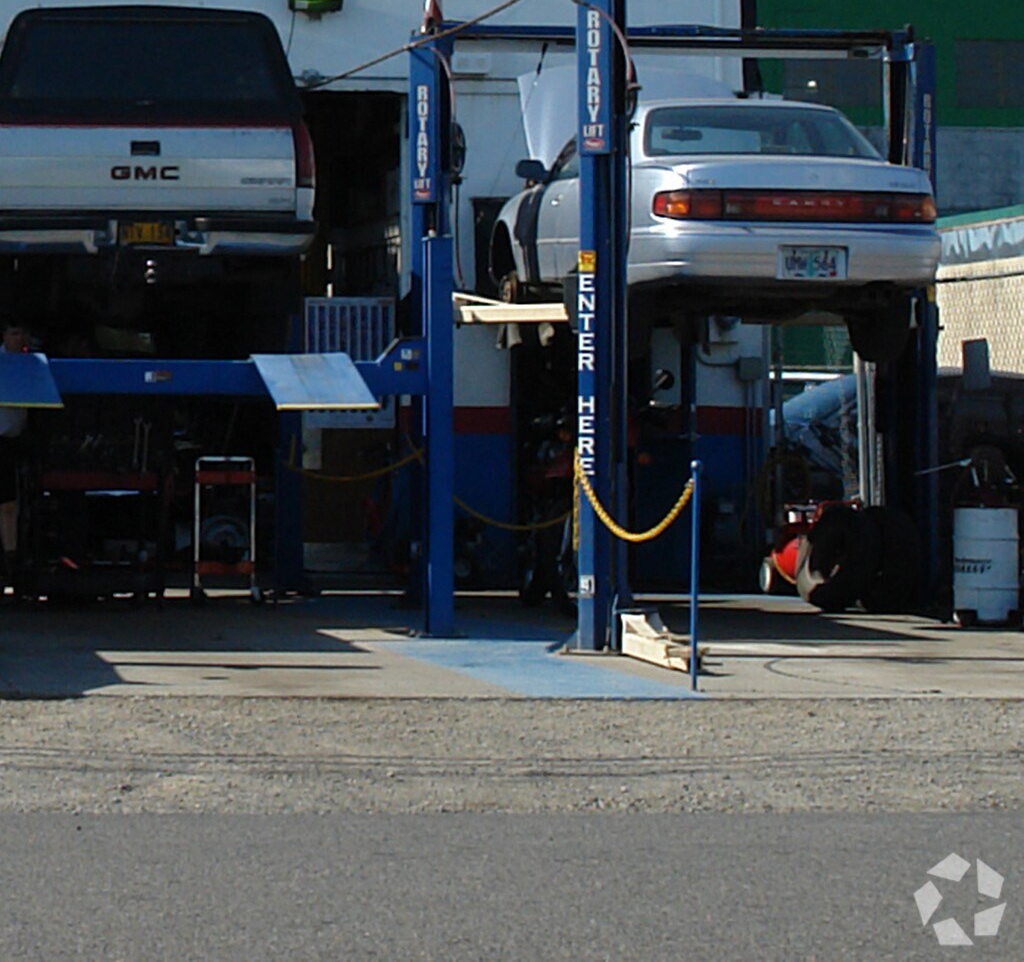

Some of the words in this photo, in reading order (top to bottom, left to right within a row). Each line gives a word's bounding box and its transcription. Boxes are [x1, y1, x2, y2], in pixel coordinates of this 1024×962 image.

[586, 10, 600, 123] ROTARY
[110, 165, 181, 181] GMC
[417, 85, 429, 177] ROTARY
[583, 124, 603, 138] LIFT
[578, 273, 595, 372] ENTER
[578, 396, 595, 476] HERE
